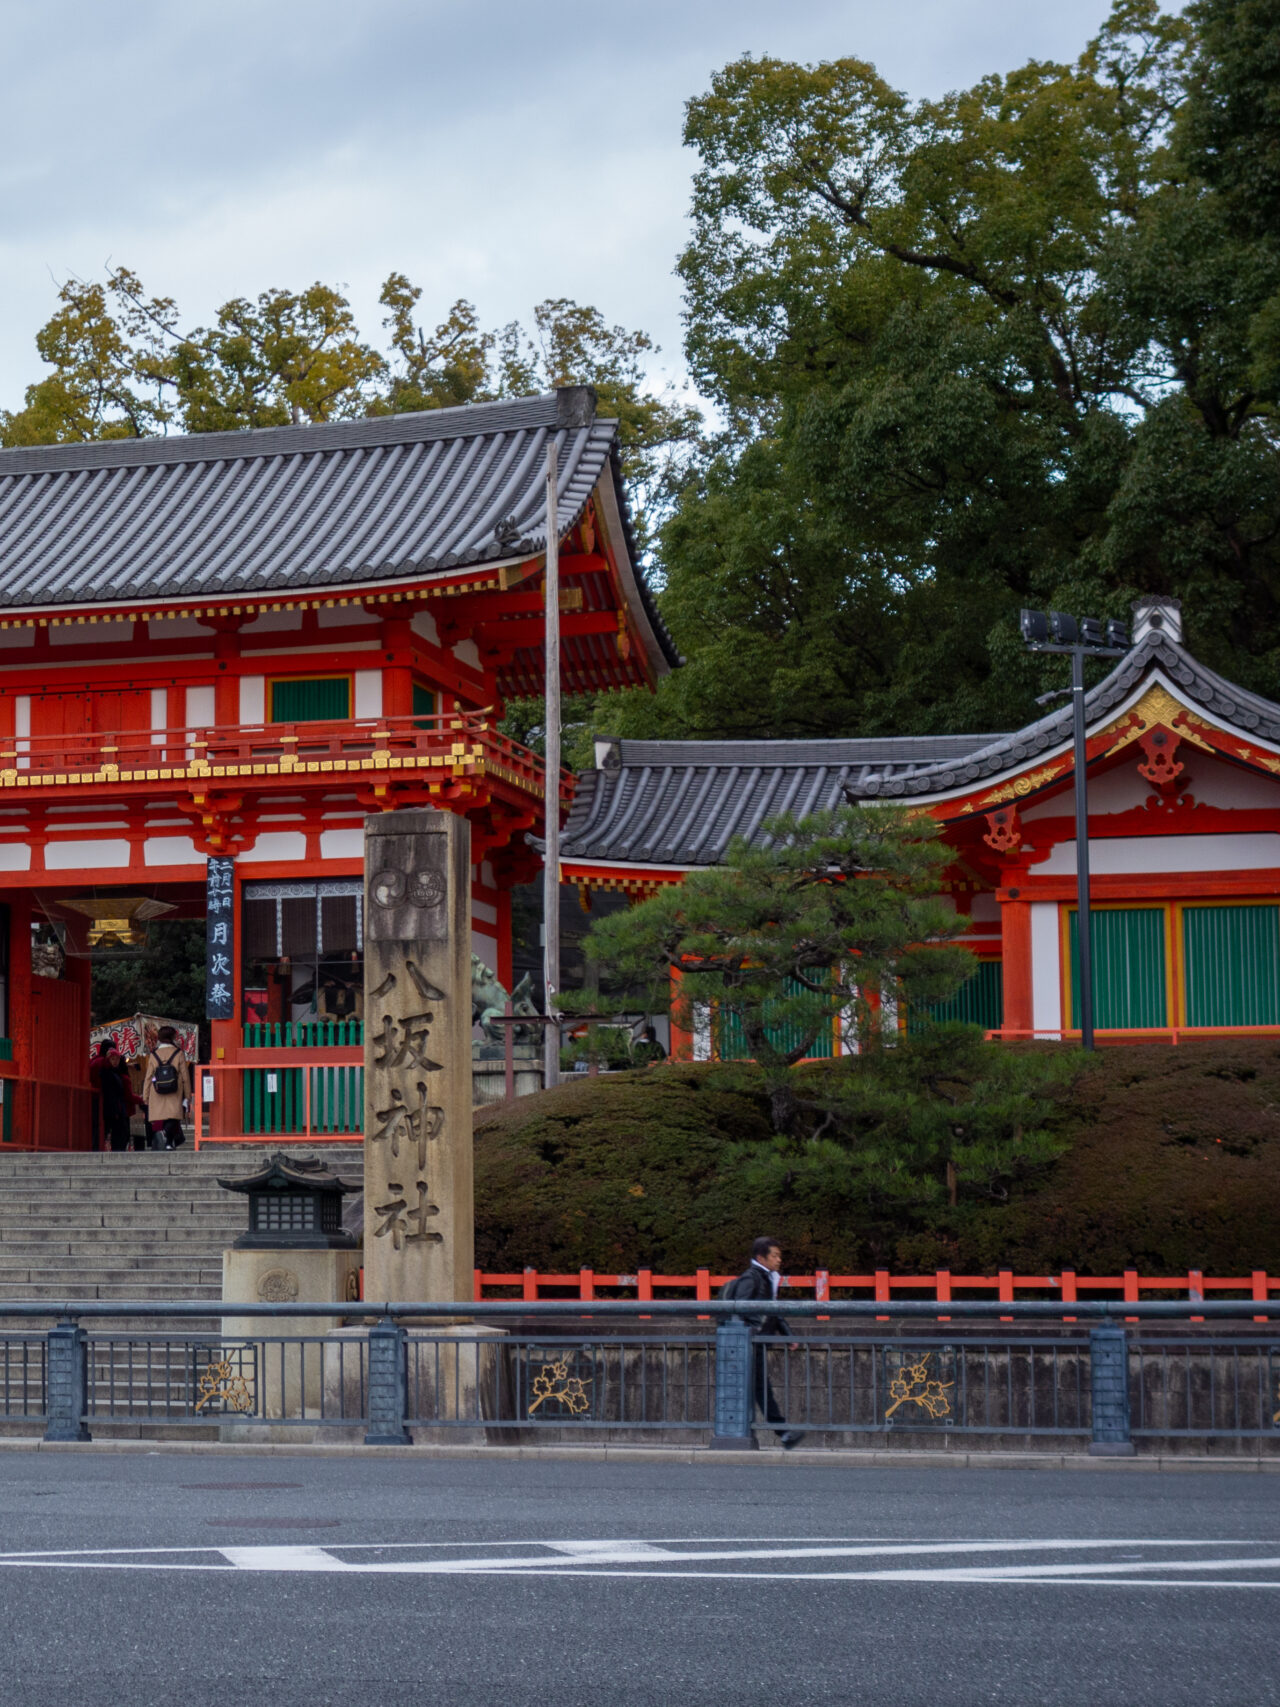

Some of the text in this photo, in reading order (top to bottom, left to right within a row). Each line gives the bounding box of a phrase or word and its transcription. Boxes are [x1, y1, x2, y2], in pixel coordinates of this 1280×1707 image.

[220, 861, 233, 908] 二月一日
[209, 922, 231, 1006] 月次祭
[369, 961, 446, 1250] 八坂神社
